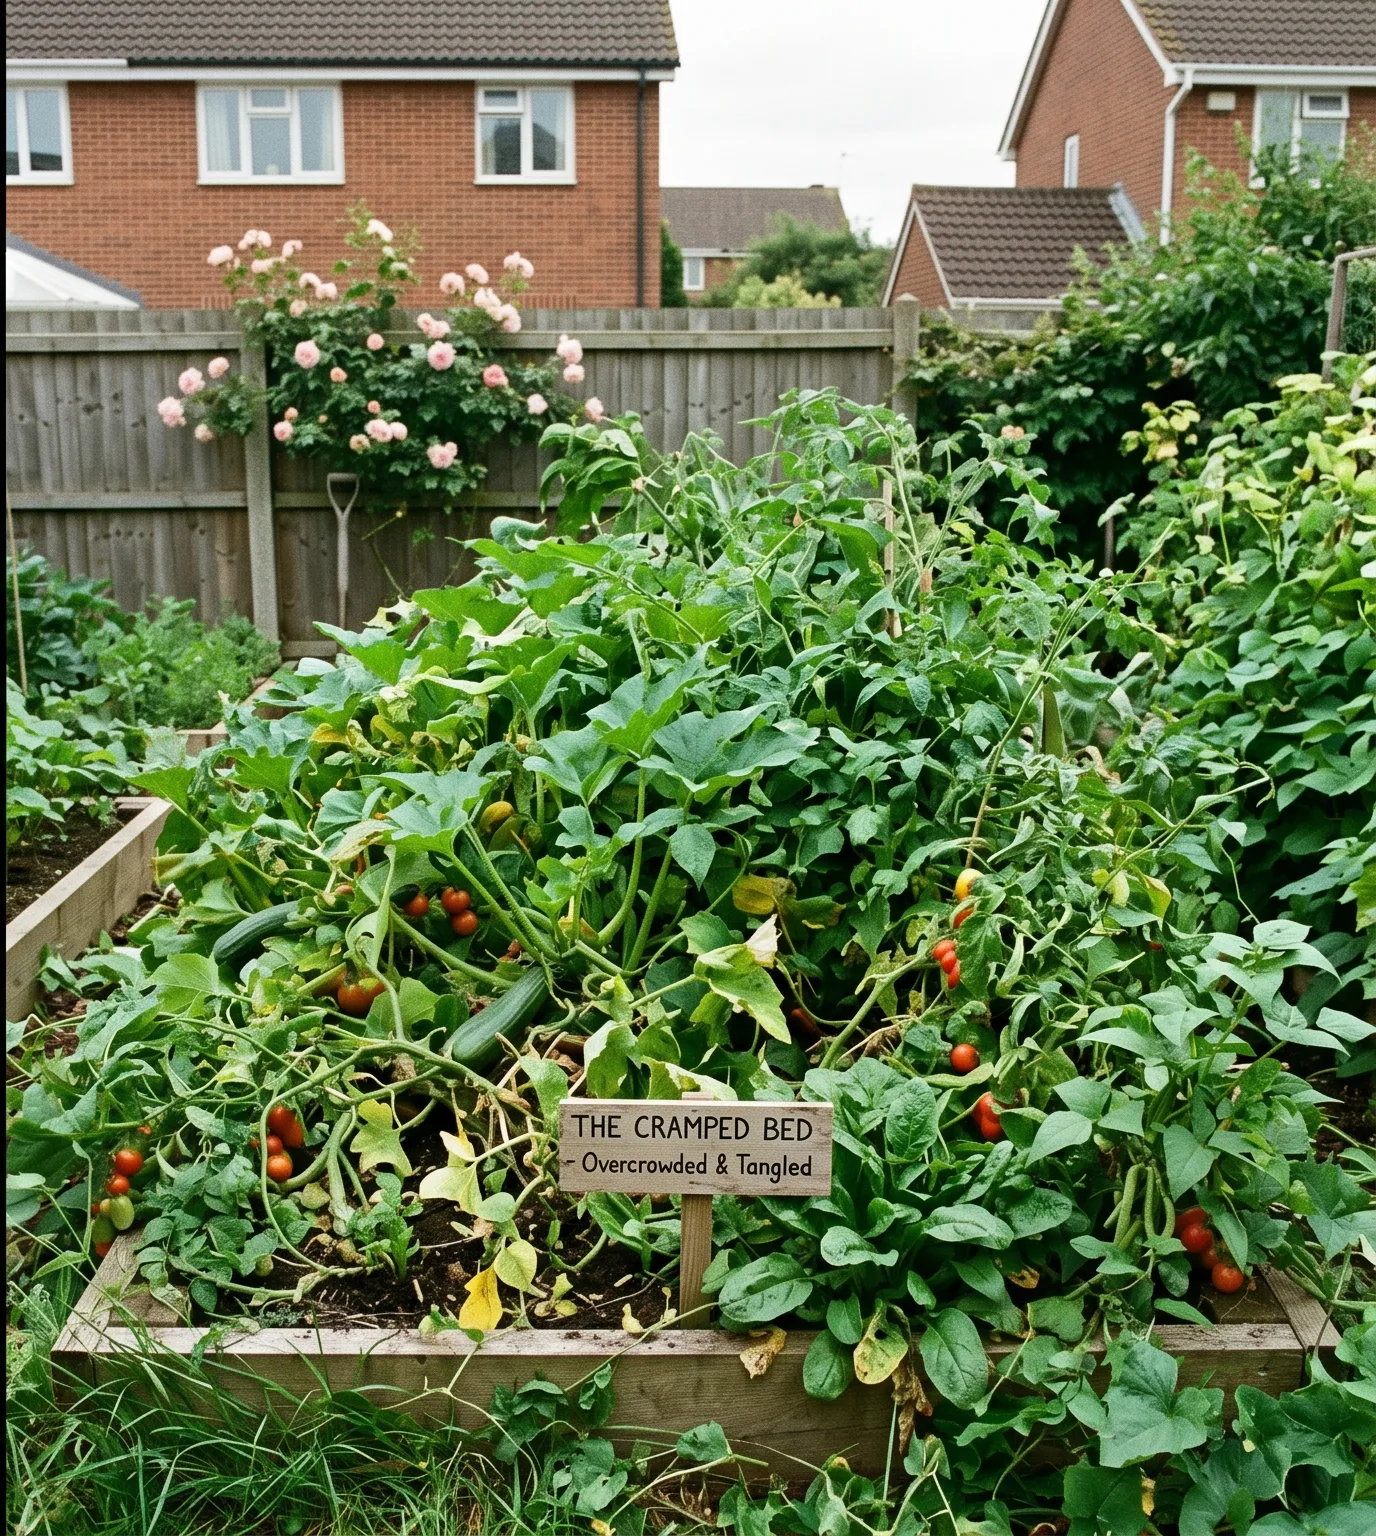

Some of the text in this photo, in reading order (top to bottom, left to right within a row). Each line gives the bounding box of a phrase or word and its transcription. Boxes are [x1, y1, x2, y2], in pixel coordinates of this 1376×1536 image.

[570, 1114, 813, 1142] THE CRAMPED BED
[581, 1151, 707, 1175] Overcrowded
[715, 1153, 729, 1175] &
[735, 1153, 812, 1184] Tangled
